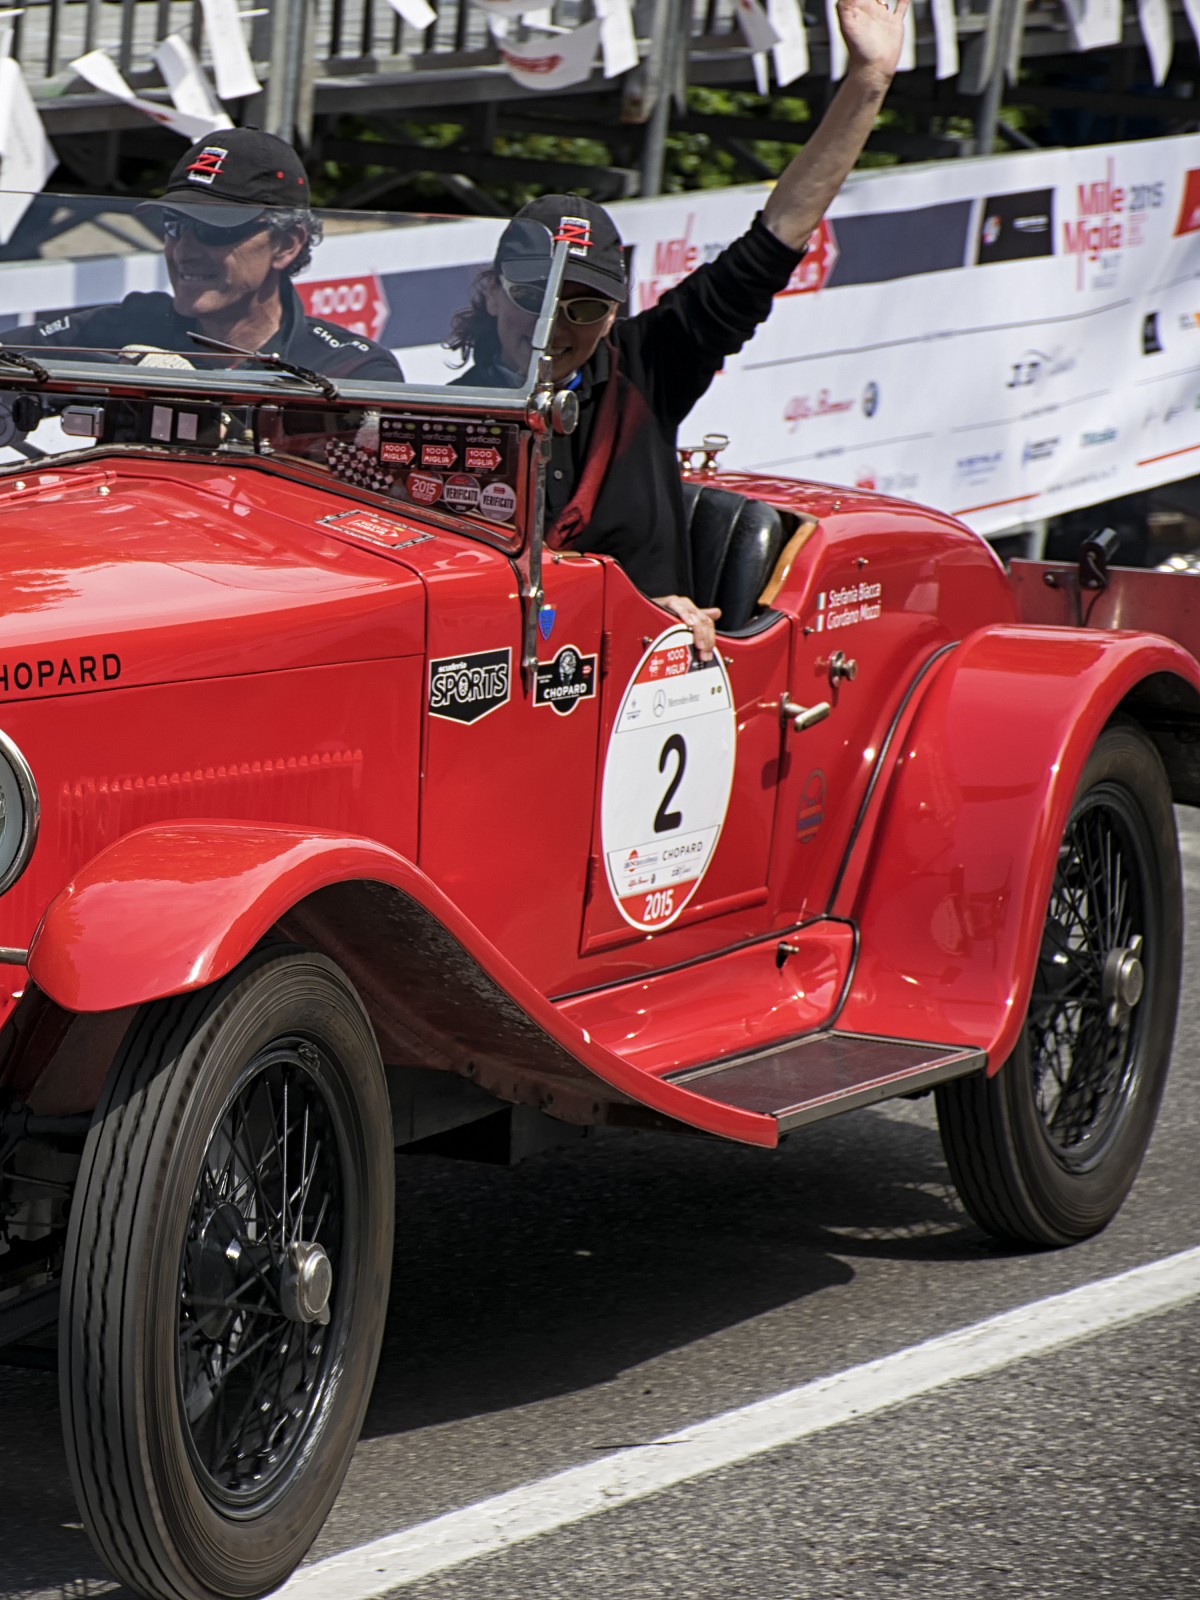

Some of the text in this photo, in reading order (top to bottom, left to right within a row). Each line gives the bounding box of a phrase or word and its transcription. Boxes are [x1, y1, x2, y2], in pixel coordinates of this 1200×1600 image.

[310, 284, 368, 317] 1000
[384, 445, 407, 453] 1000
[469, 450, 492, 458] 1000
[411, 479, 437, 495] 2015
[445, 487, 479, 502] VERIFICATO
[482, 494, 515, 509] VERIFICATO
[666, 648, 685, 661] 1000
[431, 663, 508, 707] SPORTS
[543, 682, 587, 699] CHOPARD
[654, 733, 687, 834] 2
[662, 841, 703, 861] CHOPARD
[643, 888, 675, 921] 2015
